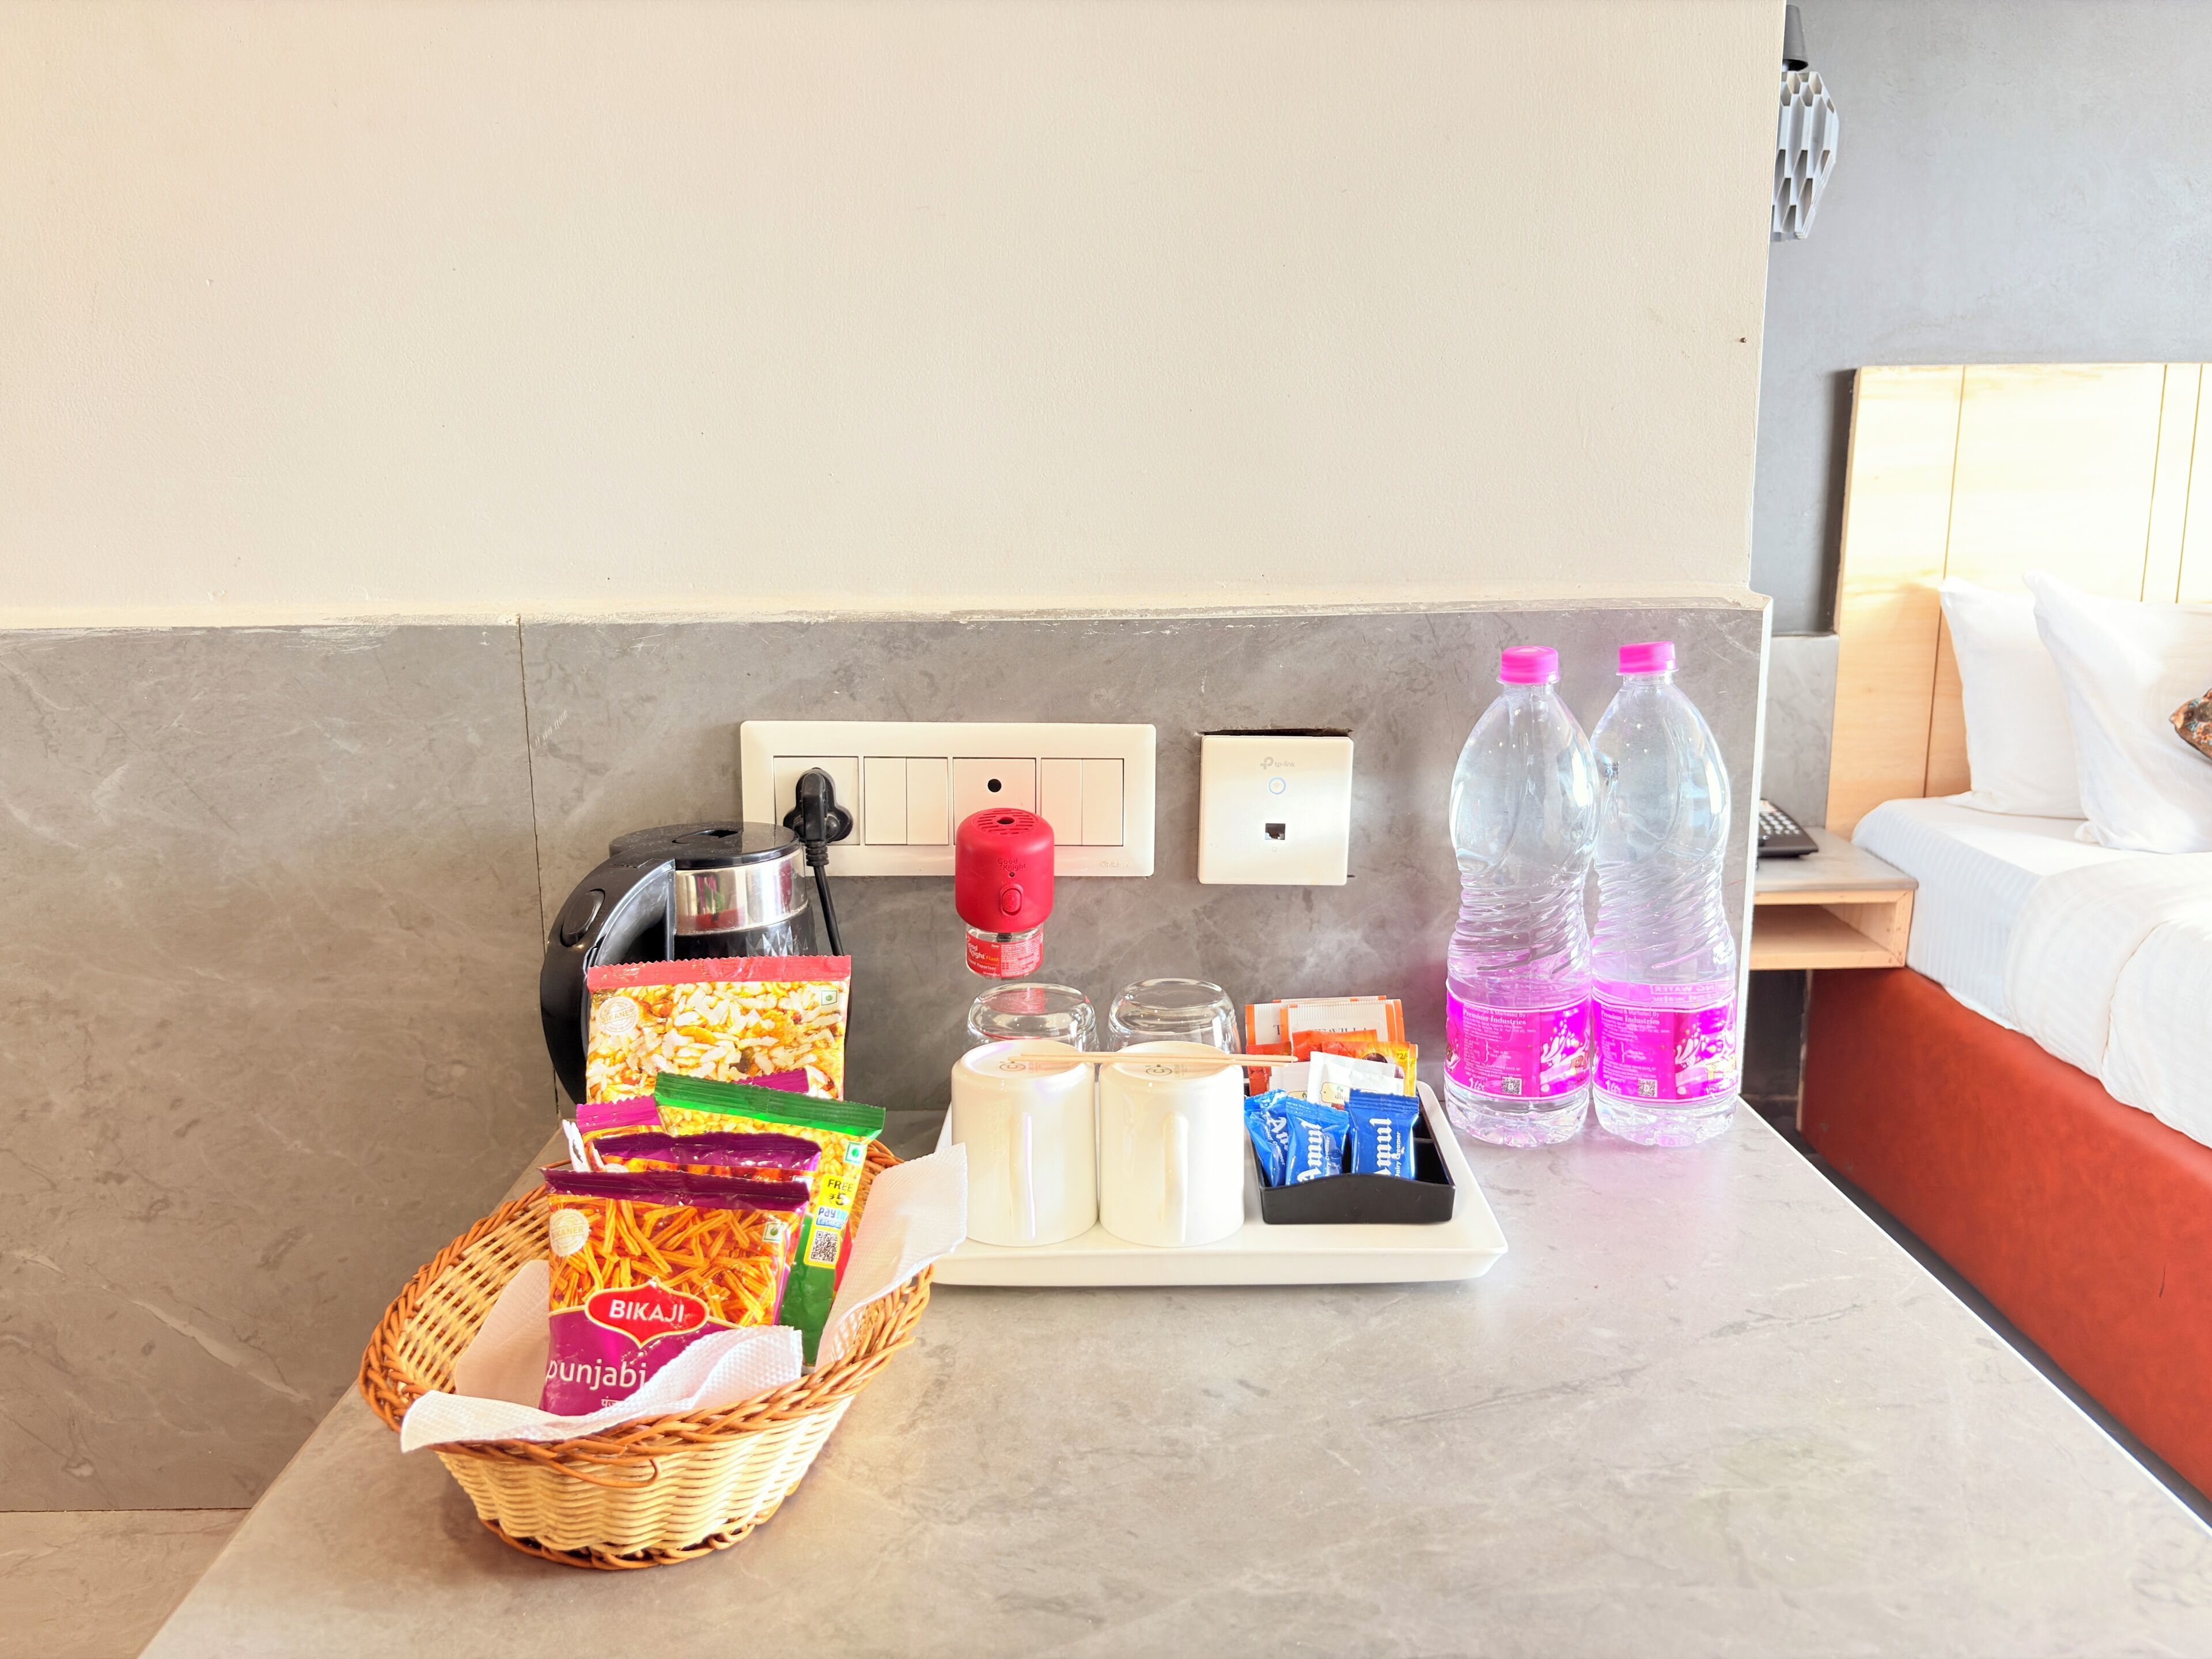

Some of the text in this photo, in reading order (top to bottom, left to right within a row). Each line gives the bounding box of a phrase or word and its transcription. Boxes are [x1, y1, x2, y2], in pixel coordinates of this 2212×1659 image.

[998, 858, 1018, 866] Good
[1003, 863, 1026, 872] Knight
[1463, 1009, 1527, 1025] Premium Industries
[1601, 1008, 1623, 1021] Premium
[1625, 1014, 1660, 1025] Industries
[1297, 1119, 1323, 1182] Amul
[827, 1179, 854, 1192] FREE
[609, 1299, 685, 1323] BIKAJI
[545, 1358, 647, 1391] punjabi
